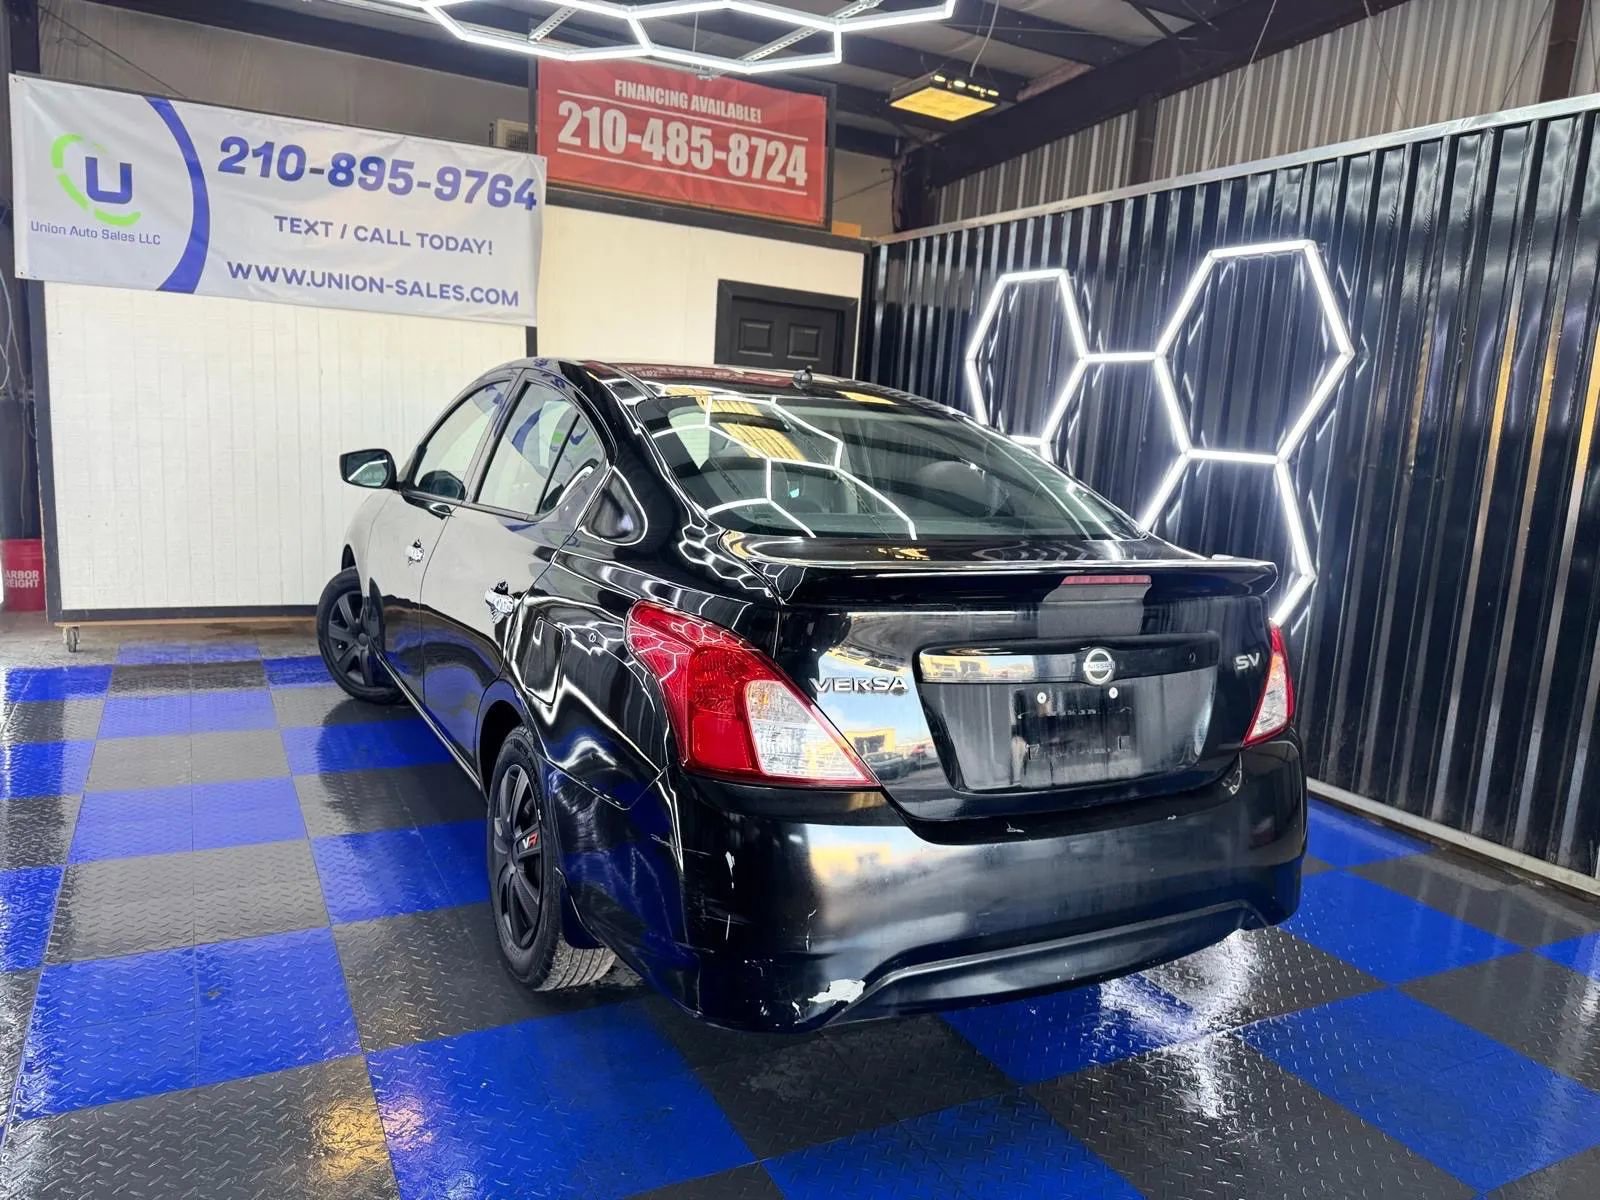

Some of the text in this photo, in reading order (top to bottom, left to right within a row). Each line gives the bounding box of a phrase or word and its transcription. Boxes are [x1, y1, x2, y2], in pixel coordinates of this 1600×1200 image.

[614, 79, 762, 124] FINANCING AVAILABLE!
[558, 101, 808, 186] 210-485-8724
[217, 136, 537, 210] 210-895-9764
[31, 221, 160, 245] Union Auto Sales LLC
[274, 215, 493, 255] TEXT / CALL TODAY!
[227, 261, 519, 307] WWW.UNION-SALES.COM
[1086, 661, 1114, 670] NISSAN
[1235, 652, 1260, 670] SV
[809, 676, 909, 693] VERSA
[522, 832, 538, 848] VR
